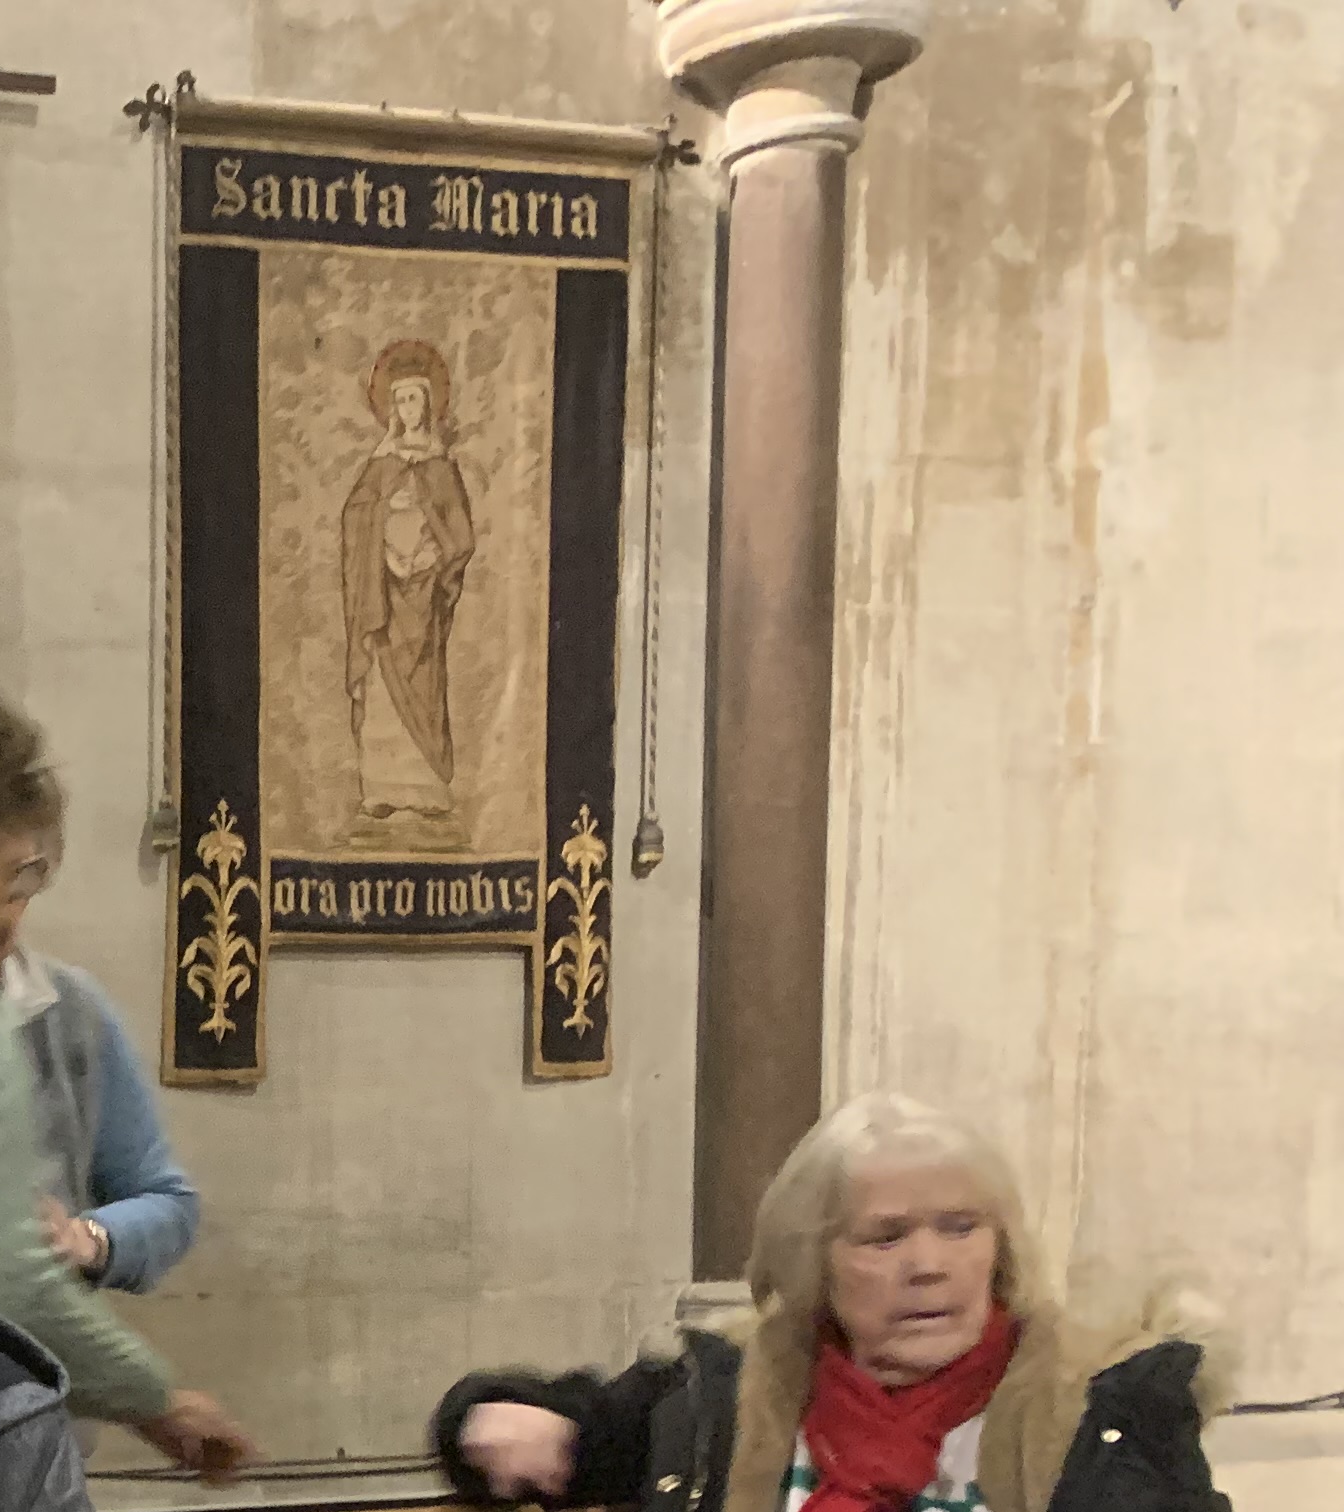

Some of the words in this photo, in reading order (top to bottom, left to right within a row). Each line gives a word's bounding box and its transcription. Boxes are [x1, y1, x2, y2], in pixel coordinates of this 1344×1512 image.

[212, 157, 408, 230] Sancta
[428, 173, 599, 240] Maria
[273, 876, 338, 917] ora
[348, 876, 416, 924] pro
[426, 870, 534, 917] nobis
